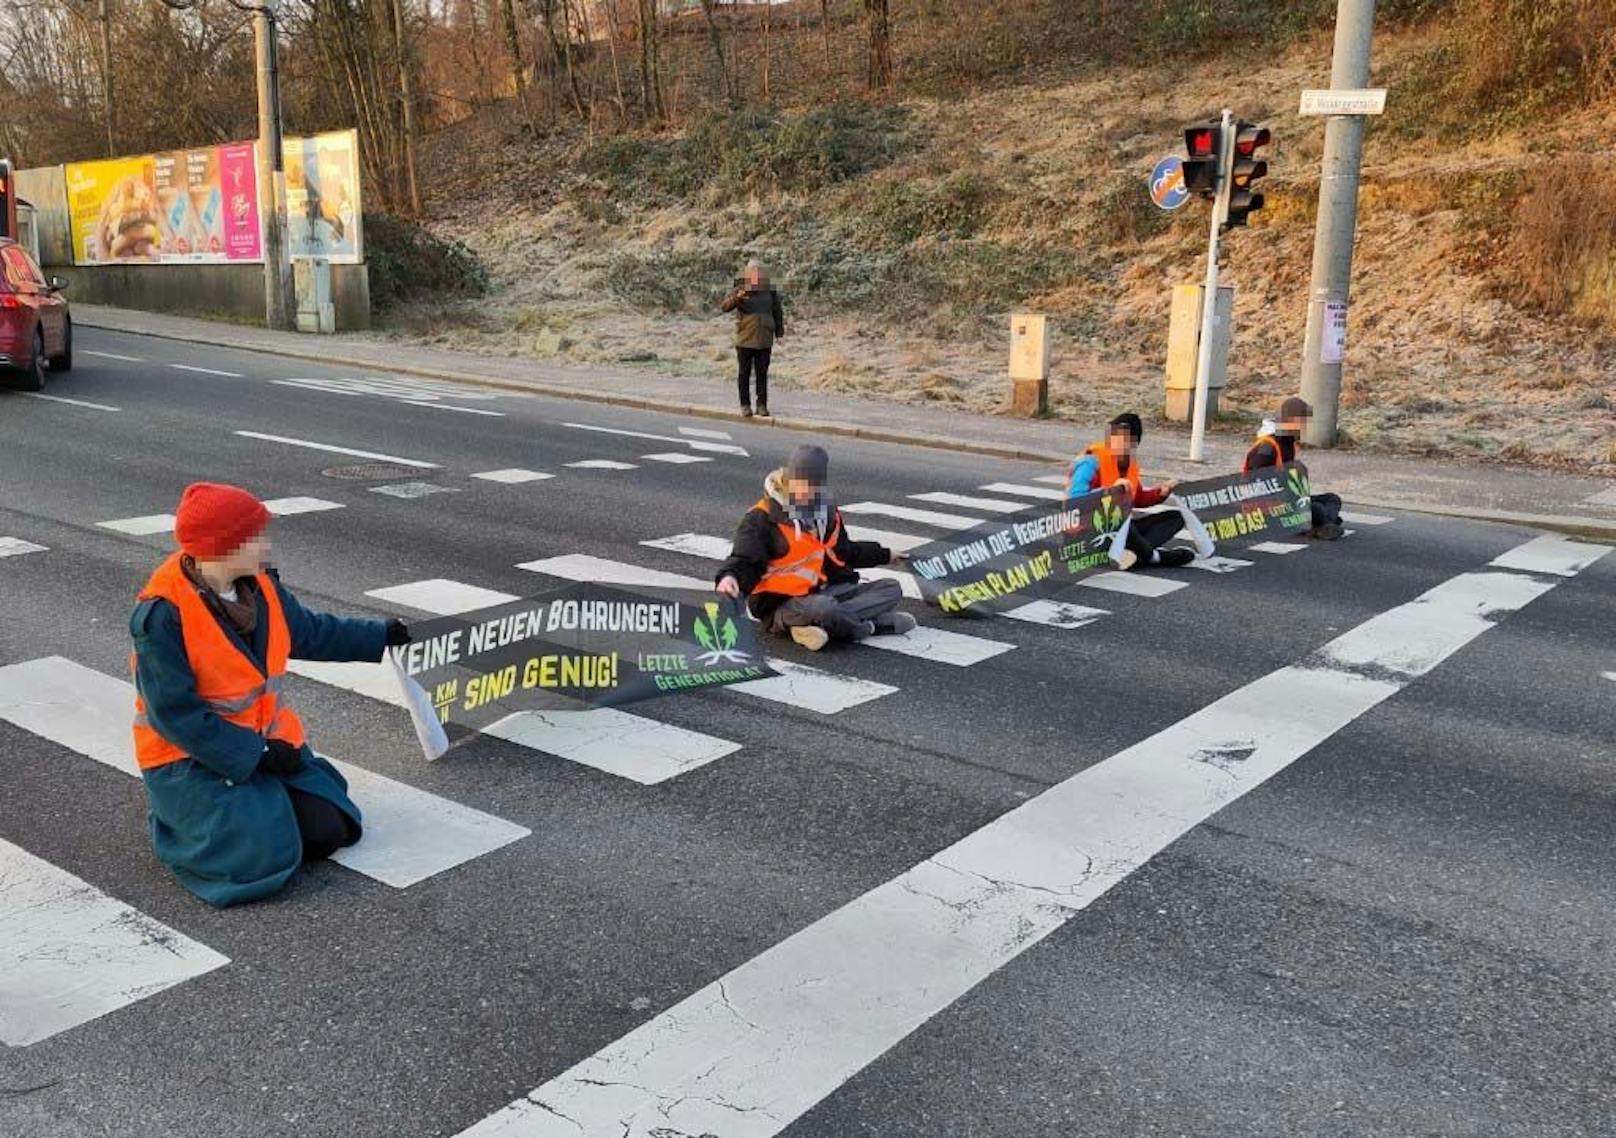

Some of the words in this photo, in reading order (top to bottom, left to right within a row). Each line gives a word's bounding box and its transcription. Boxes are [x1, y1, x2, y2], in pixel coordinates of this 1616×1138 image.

[944, 539, 994, 572] WENN
[988, 530, 1016, 556] DIE
[1012, 508, 1081, 546] REGIERUNG
[986, 563, 1031, 596] PLAN
[467, 608, 543, 656] NEUEN
[546, 599, 680, 634] BOHRUNGEN!
[464, 664, 517, 711] SIND
[522, 652, 619, 689] GENUG!
[638, 651, 689, 673] LETZTE
[436, 678, 458, 703] KM
